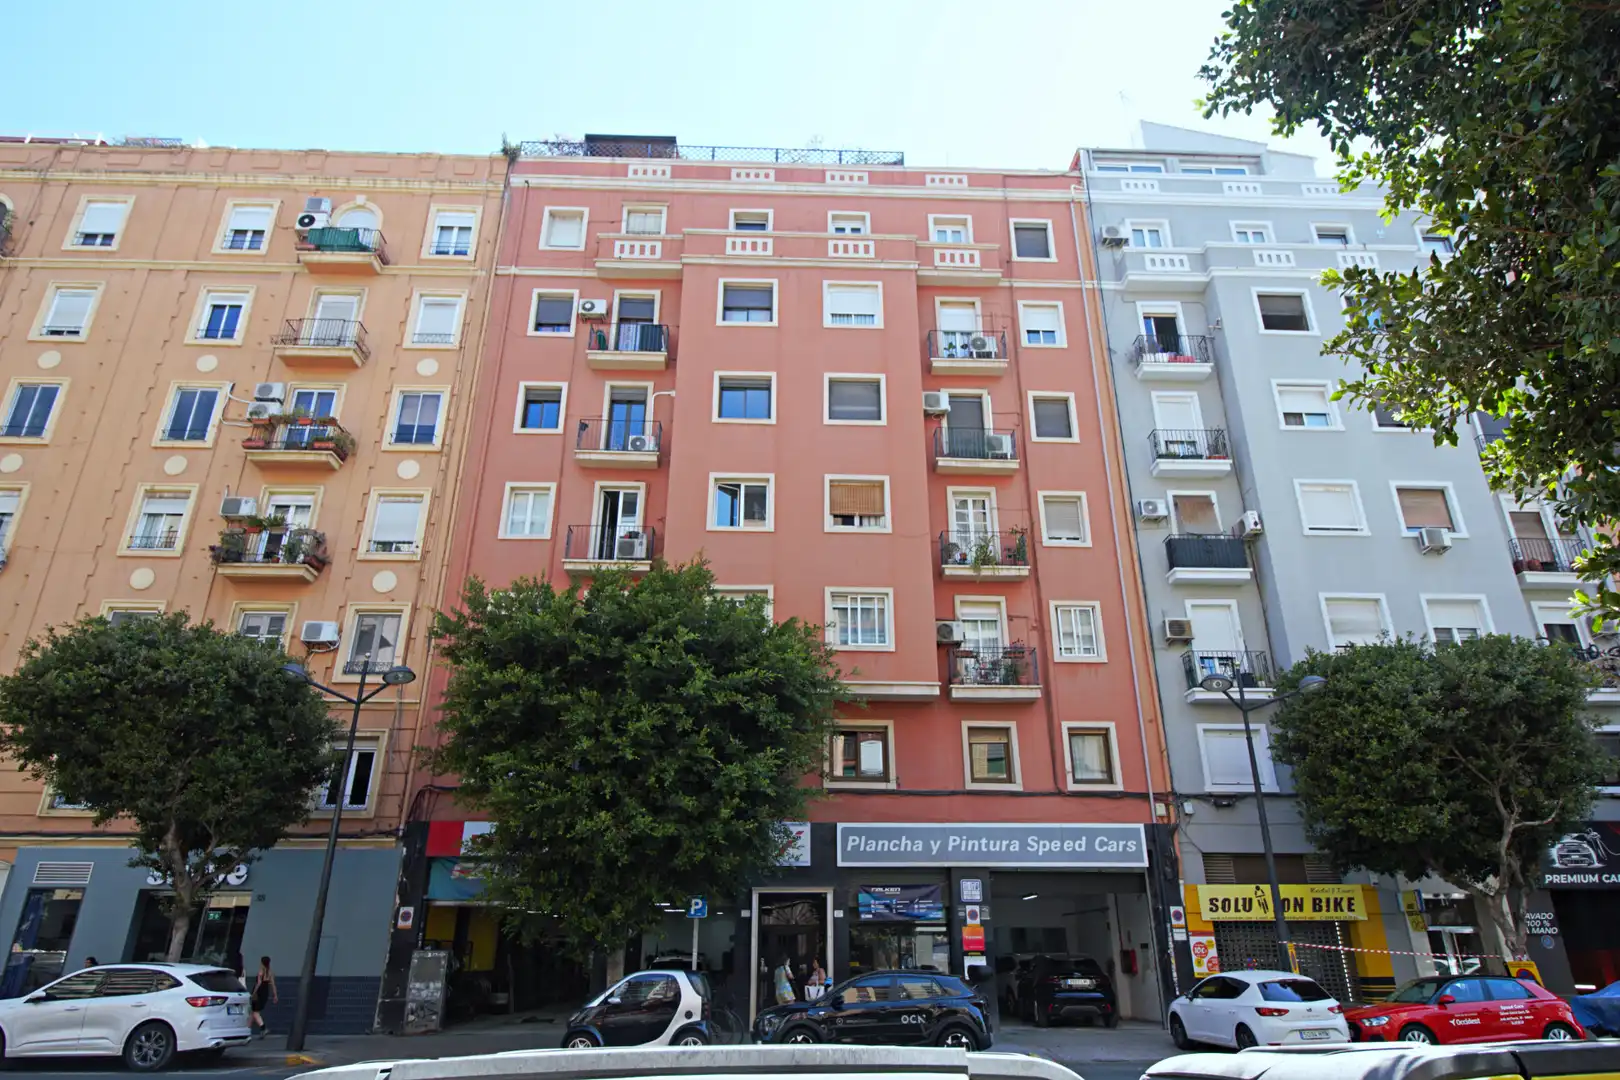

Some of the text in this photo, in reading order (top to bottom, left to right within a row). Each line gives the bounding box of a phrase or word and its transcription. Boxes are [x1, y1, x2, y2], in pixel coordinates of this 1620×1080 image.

[846, 835, 1137, 856] Plancha y Pintura Speed Cars
[1544, 874, 1599, 884] PREMIUM
[690, 899, 703, 915] P
[1312, 897, 1356, 913] BIKE
[1525, 912, 1554, 920] AVADO
[1531, 927, 1559, 935] MANO
[1456, 1018, 1481, 1026] Occident
